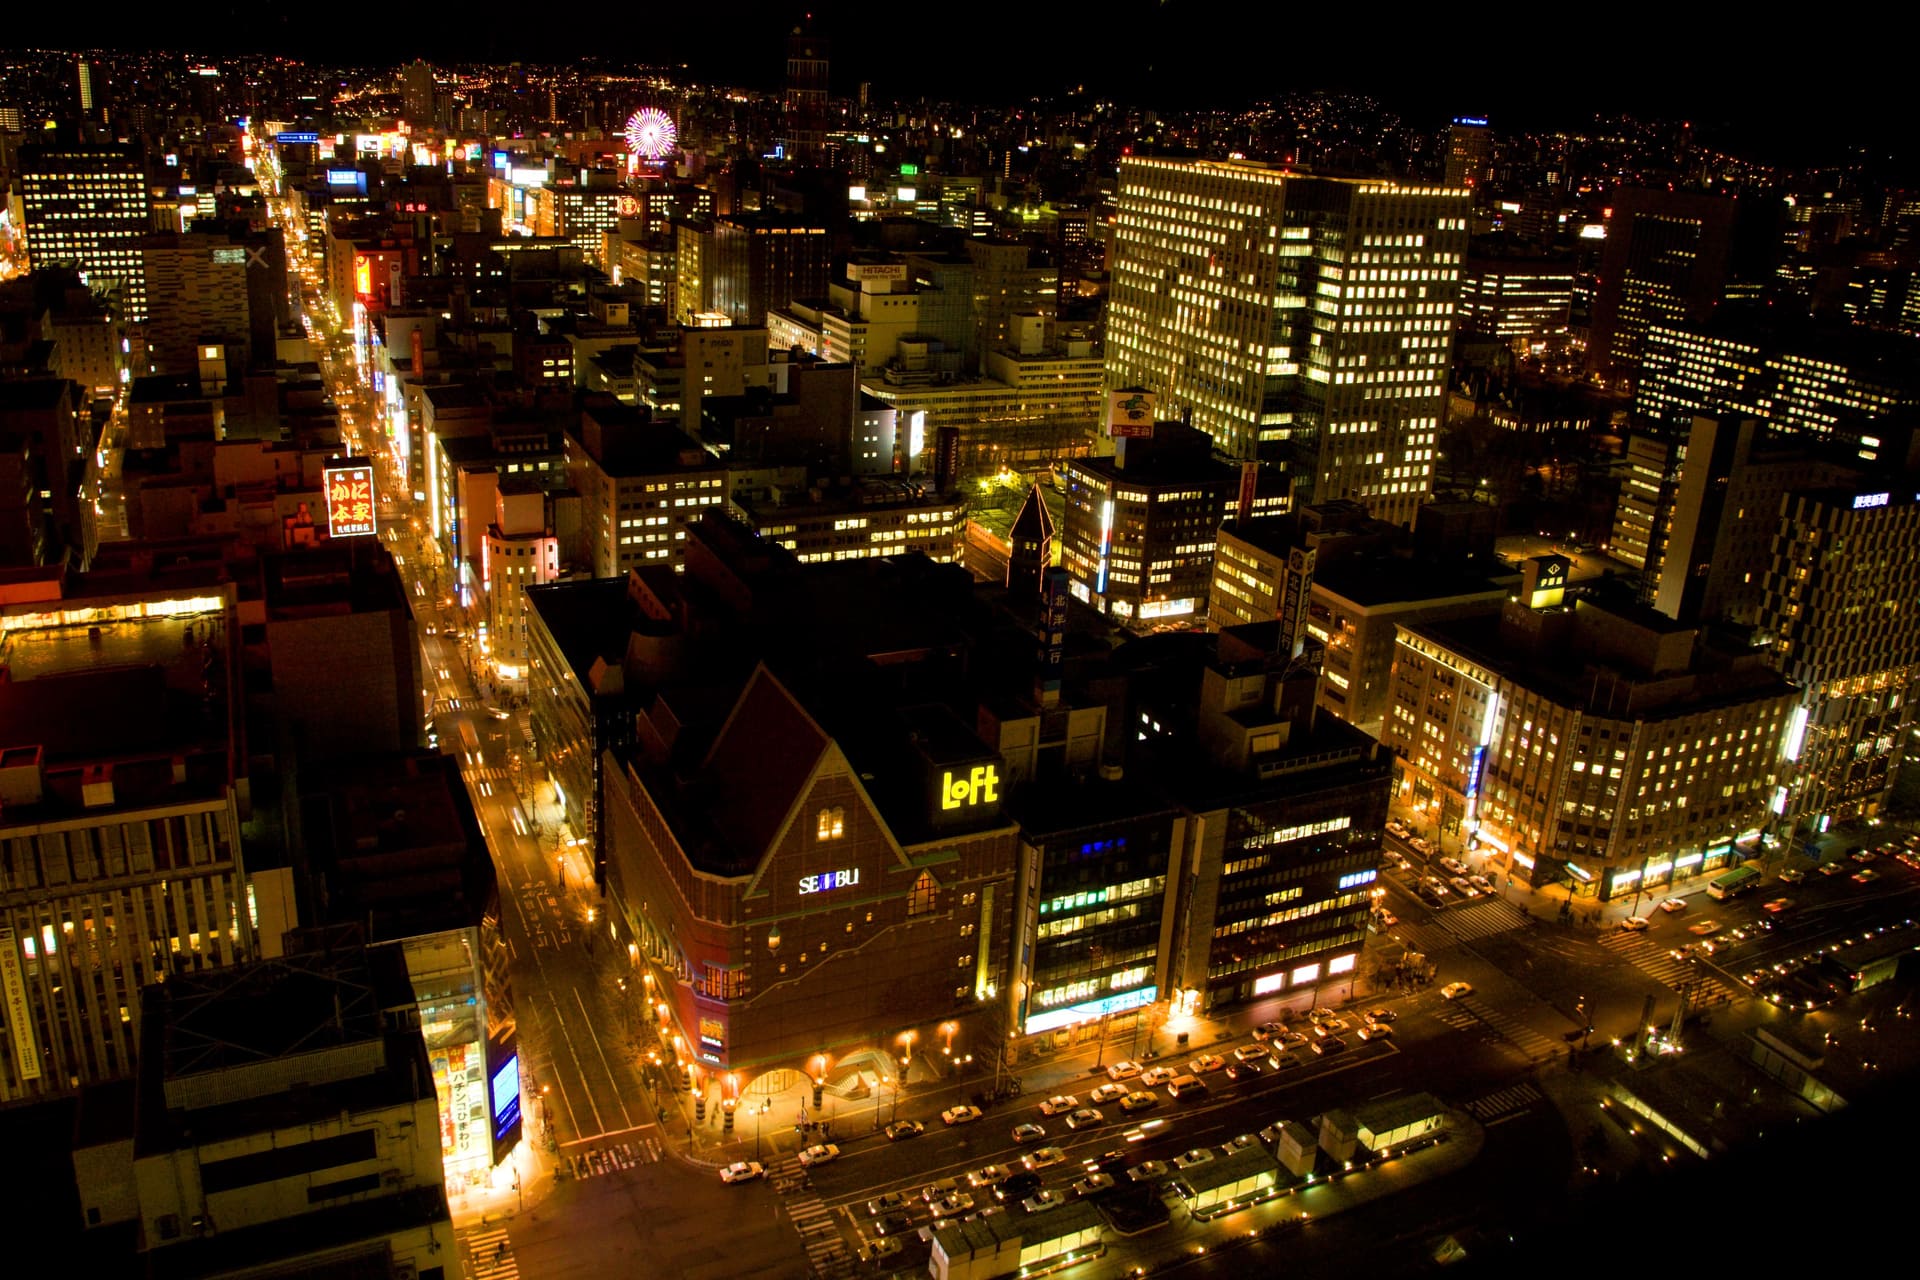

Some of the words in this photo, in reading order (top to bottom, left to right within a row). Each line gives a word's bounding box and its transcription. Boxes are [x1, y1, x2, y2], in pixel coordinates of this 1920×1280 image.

[863, 266, 901, 274] HITACHI
[331, 482, 369, 501] かに
[331, 501, 372, 523] 本家
[799, 868, 859, 895] SEIBU
[453, 1073, 470, 1151] パチンコひまわり
